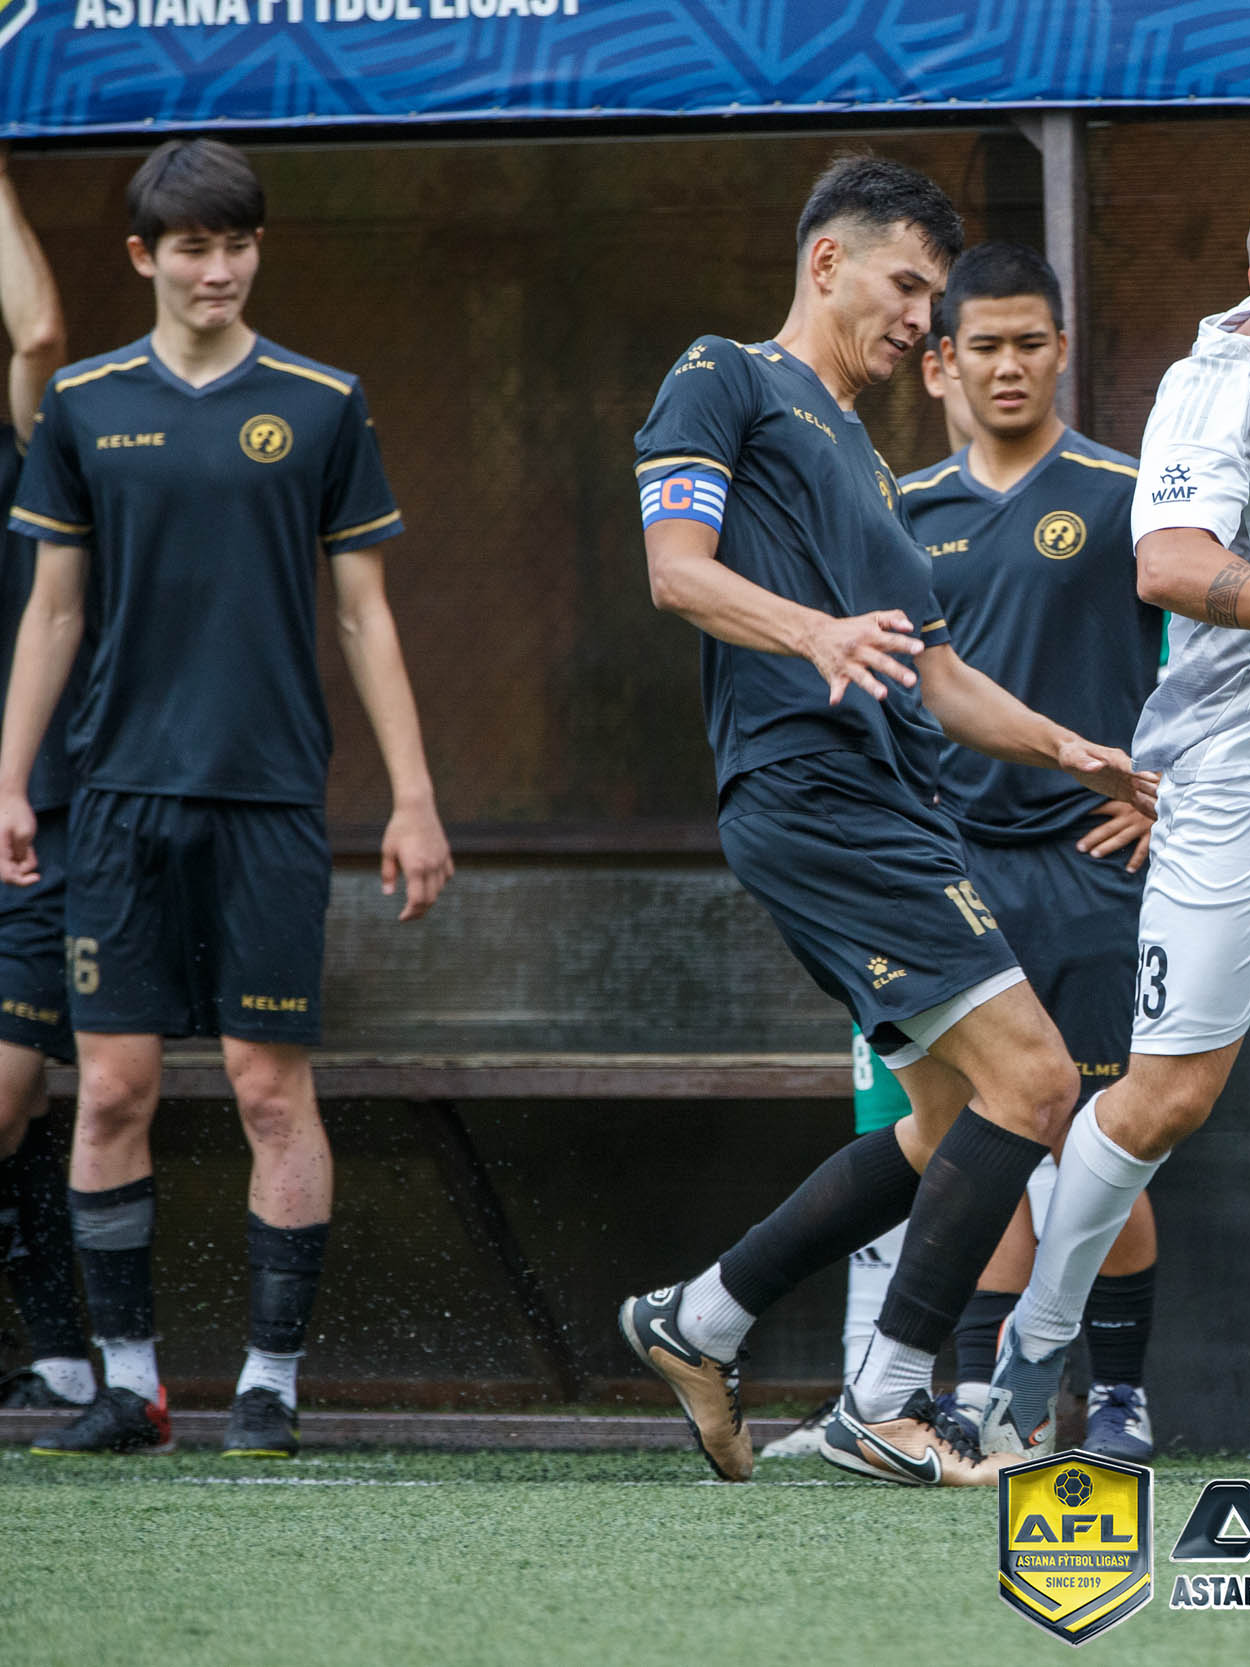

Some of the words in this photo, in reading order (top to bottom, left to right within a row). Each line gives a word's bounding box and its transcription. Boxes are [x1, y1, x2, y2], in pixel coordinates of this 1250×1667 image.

[674, 360, 716, 377] KELME
[96, 432, 166, 450] KELME
[661, 477, 693, 510] C
[1151, 485, 1198, 503] WMF
[241, 994, 308, 1012] KELME
